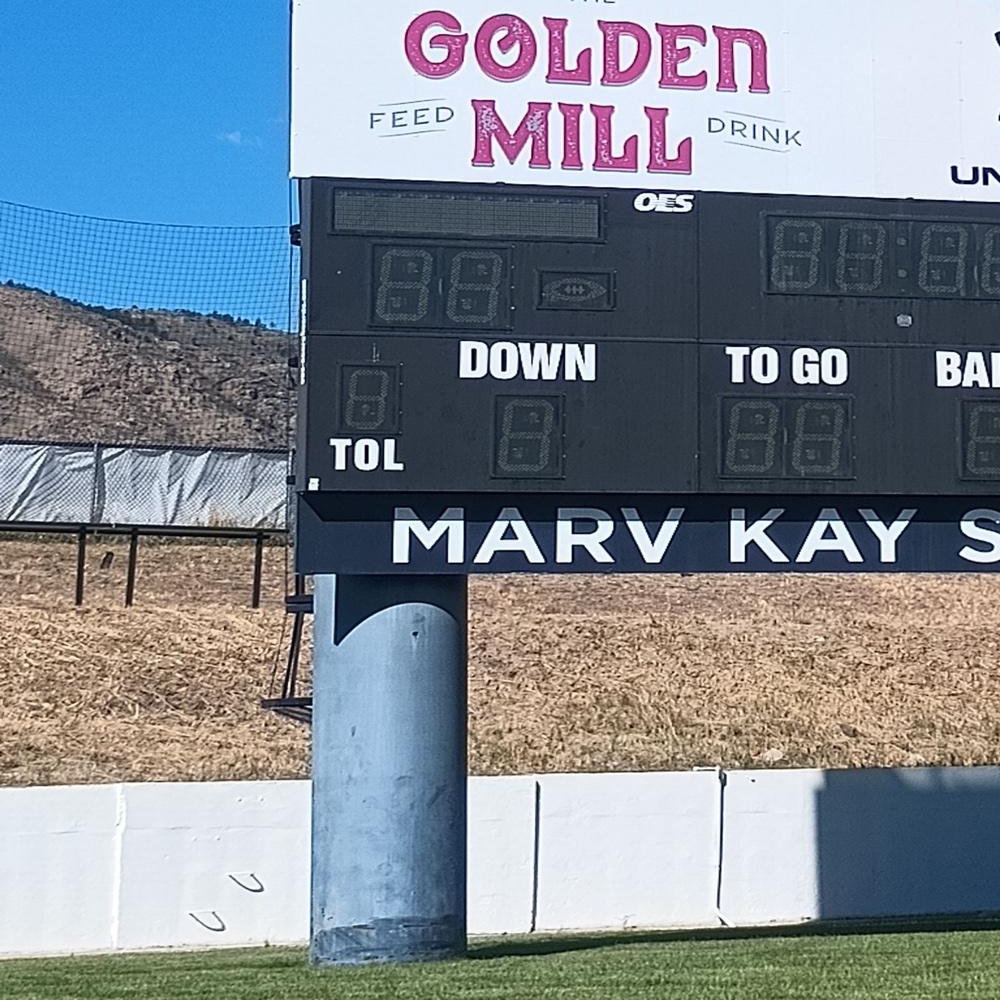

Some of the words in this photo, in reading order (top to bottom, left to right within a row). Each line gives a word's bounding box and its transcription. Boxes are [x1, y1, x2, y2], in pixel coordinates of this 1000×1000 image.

[369, 105, 455, 130] FEED
[470, 98, 693, 176] MILL
[706, 116, 802, 147] DRINK
[633, 191, 695, 214] OES
[458, 340, 598, 382] DOWN
[725, 345, 780, 385] TO
[790, 346, 850, 387] GO
[329, 436, 405, 472] TOL
[391, 506, 687, 565] MARV
[728, 507, 919, 565] KAY
